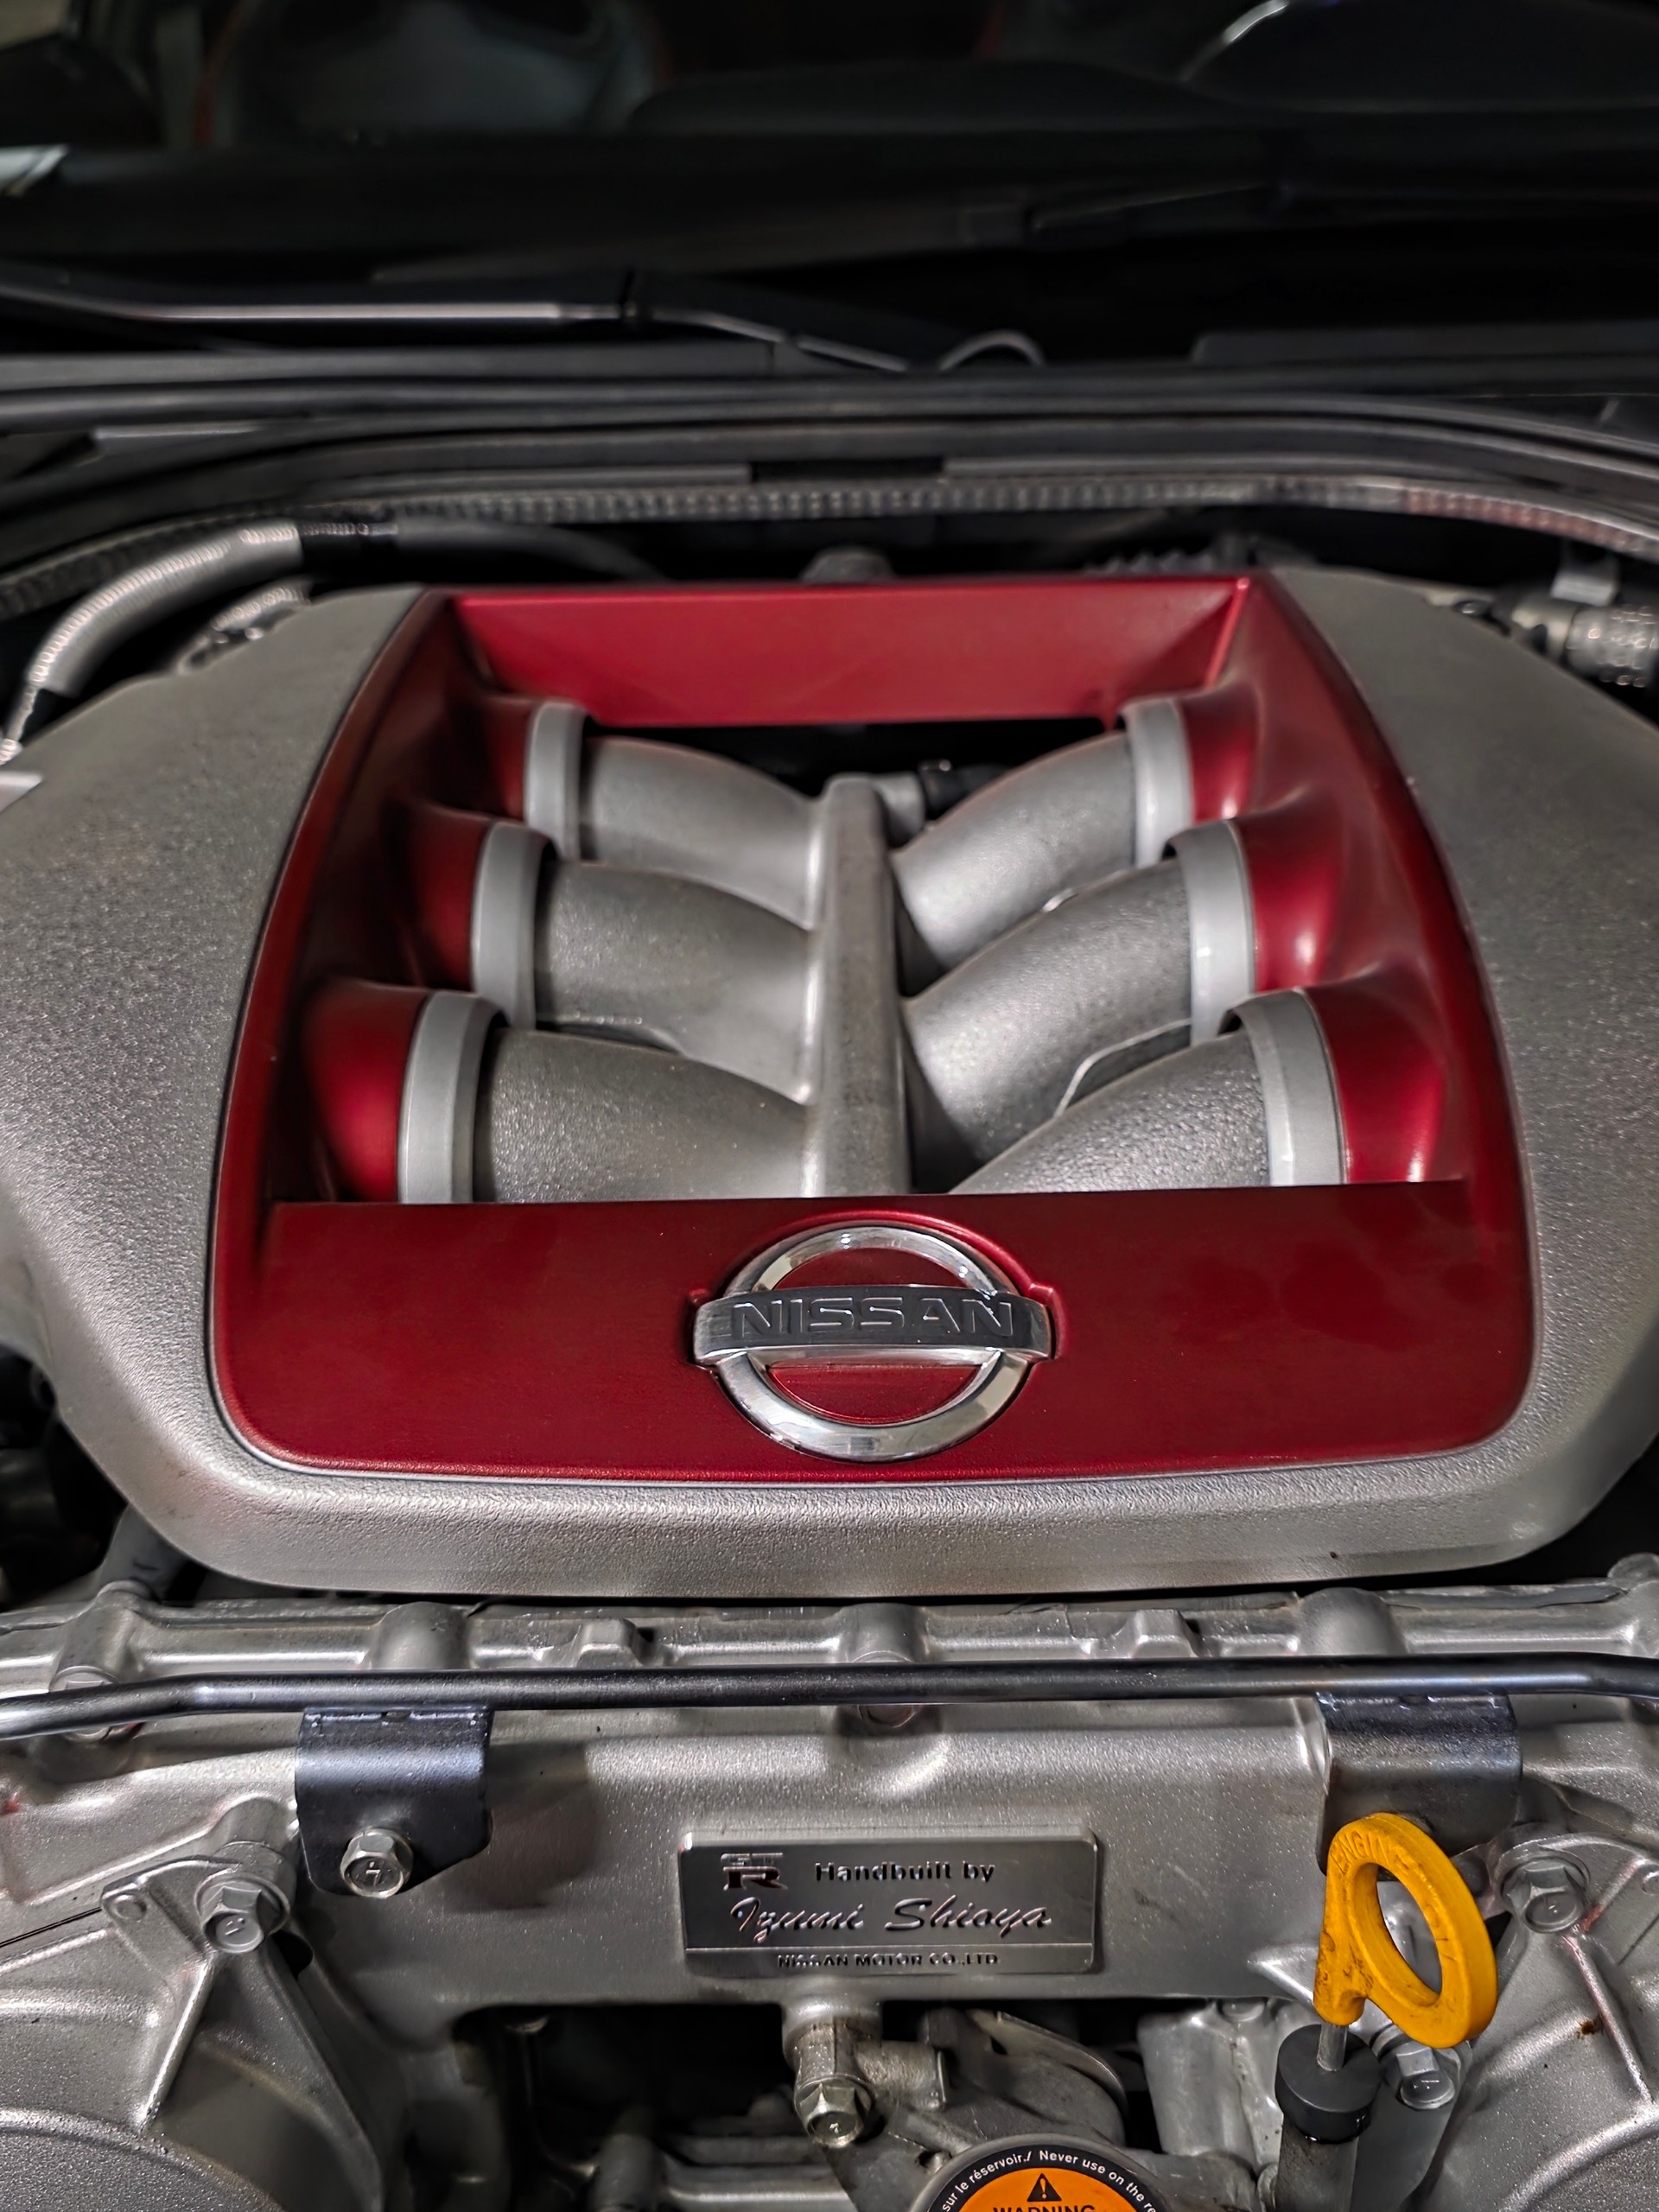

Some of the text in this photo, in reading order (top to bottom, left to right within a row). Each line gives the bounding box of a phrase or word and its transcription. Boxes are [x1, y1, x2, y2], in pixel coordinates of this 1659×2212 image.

[732, 1296, 1014, 1338] NISSAN
[815, 1860, 995, 1883] Handbuilt by
[730, 1894, 1052, 1942] Izumi Shioya
[779, 1953, 849, 1967] NISSAN
[854, 1952, 923, 1967] MOTOR
[942, 2192, 958, 2212] sur
[955, 2182, 969, 2193] le
[1039, 2150, 1078, 2164] Never
[1082, 2159, 1106, 2174] use
[1109, 2171, 1125, 2185] on
[1126, 2182, 1145, 2202] the
